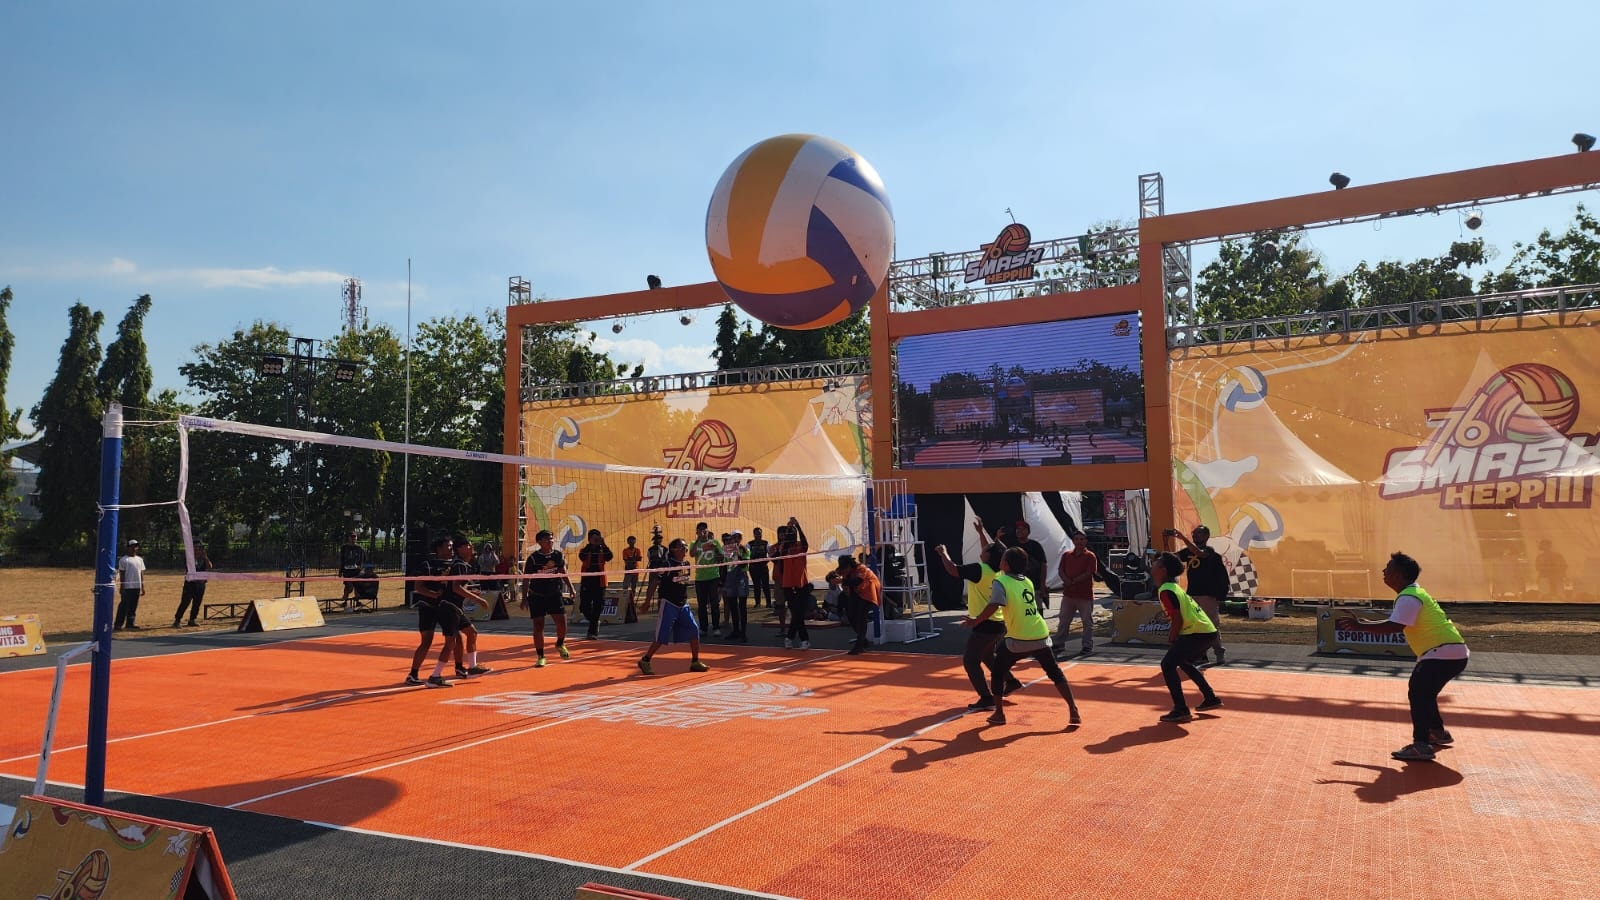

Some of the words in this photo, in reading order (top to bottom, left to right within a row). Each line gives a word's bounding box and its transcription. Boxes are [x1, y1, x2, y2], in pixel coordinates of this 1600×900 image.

[964, 248, 1044, 282] SMASH
[985, 265, 1034, 284] HEPPIII
[1424, 391, 1490, 466] 76
[638, 467, 754, 510] SMASH
[1443, 472, 1589, 507] HEPPIII
[667, 496, 739, 516] HEPPIII
[1337, 630, 1406, 644] SPORTIVITAS
